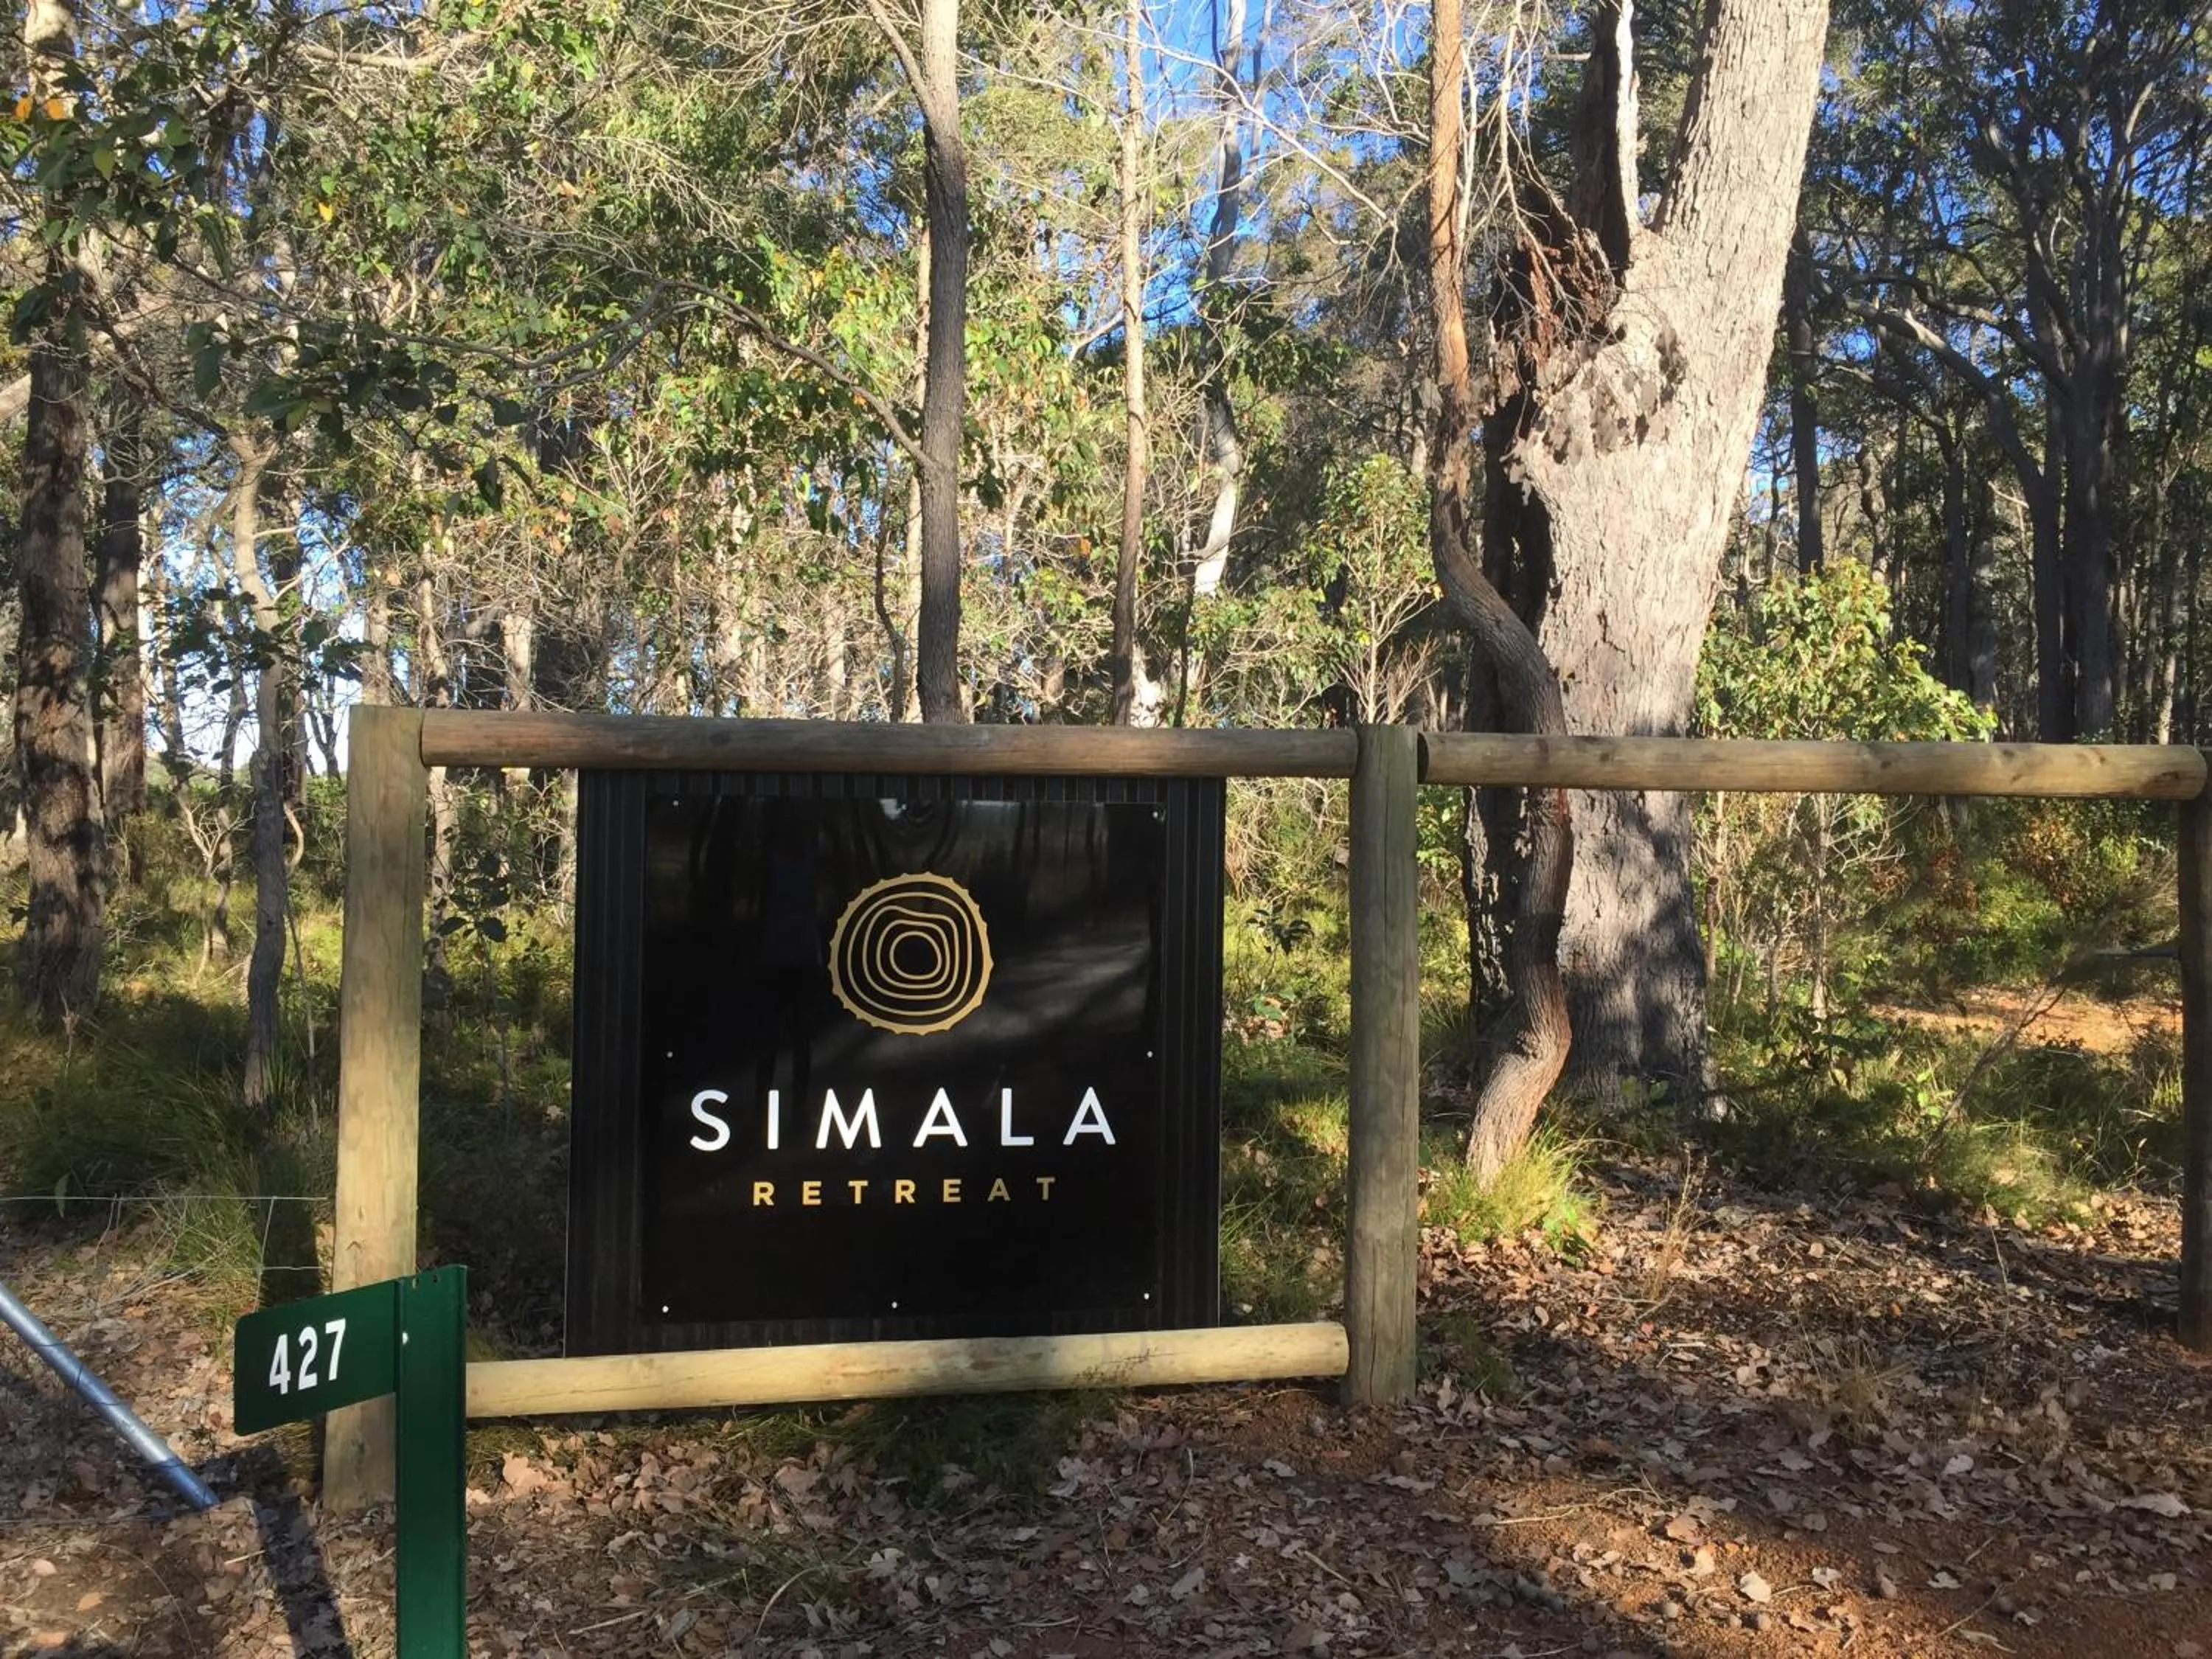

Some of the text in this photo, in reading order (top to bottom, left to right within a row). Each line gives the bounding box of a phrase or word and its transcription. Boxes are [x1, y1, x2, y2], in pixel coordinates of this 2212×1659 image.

[689, 1086, 1116, 1152] SIMALA
[752, 1178, 1056, 1207] RETREAT
[268, 1318, 347, 1396] 427
